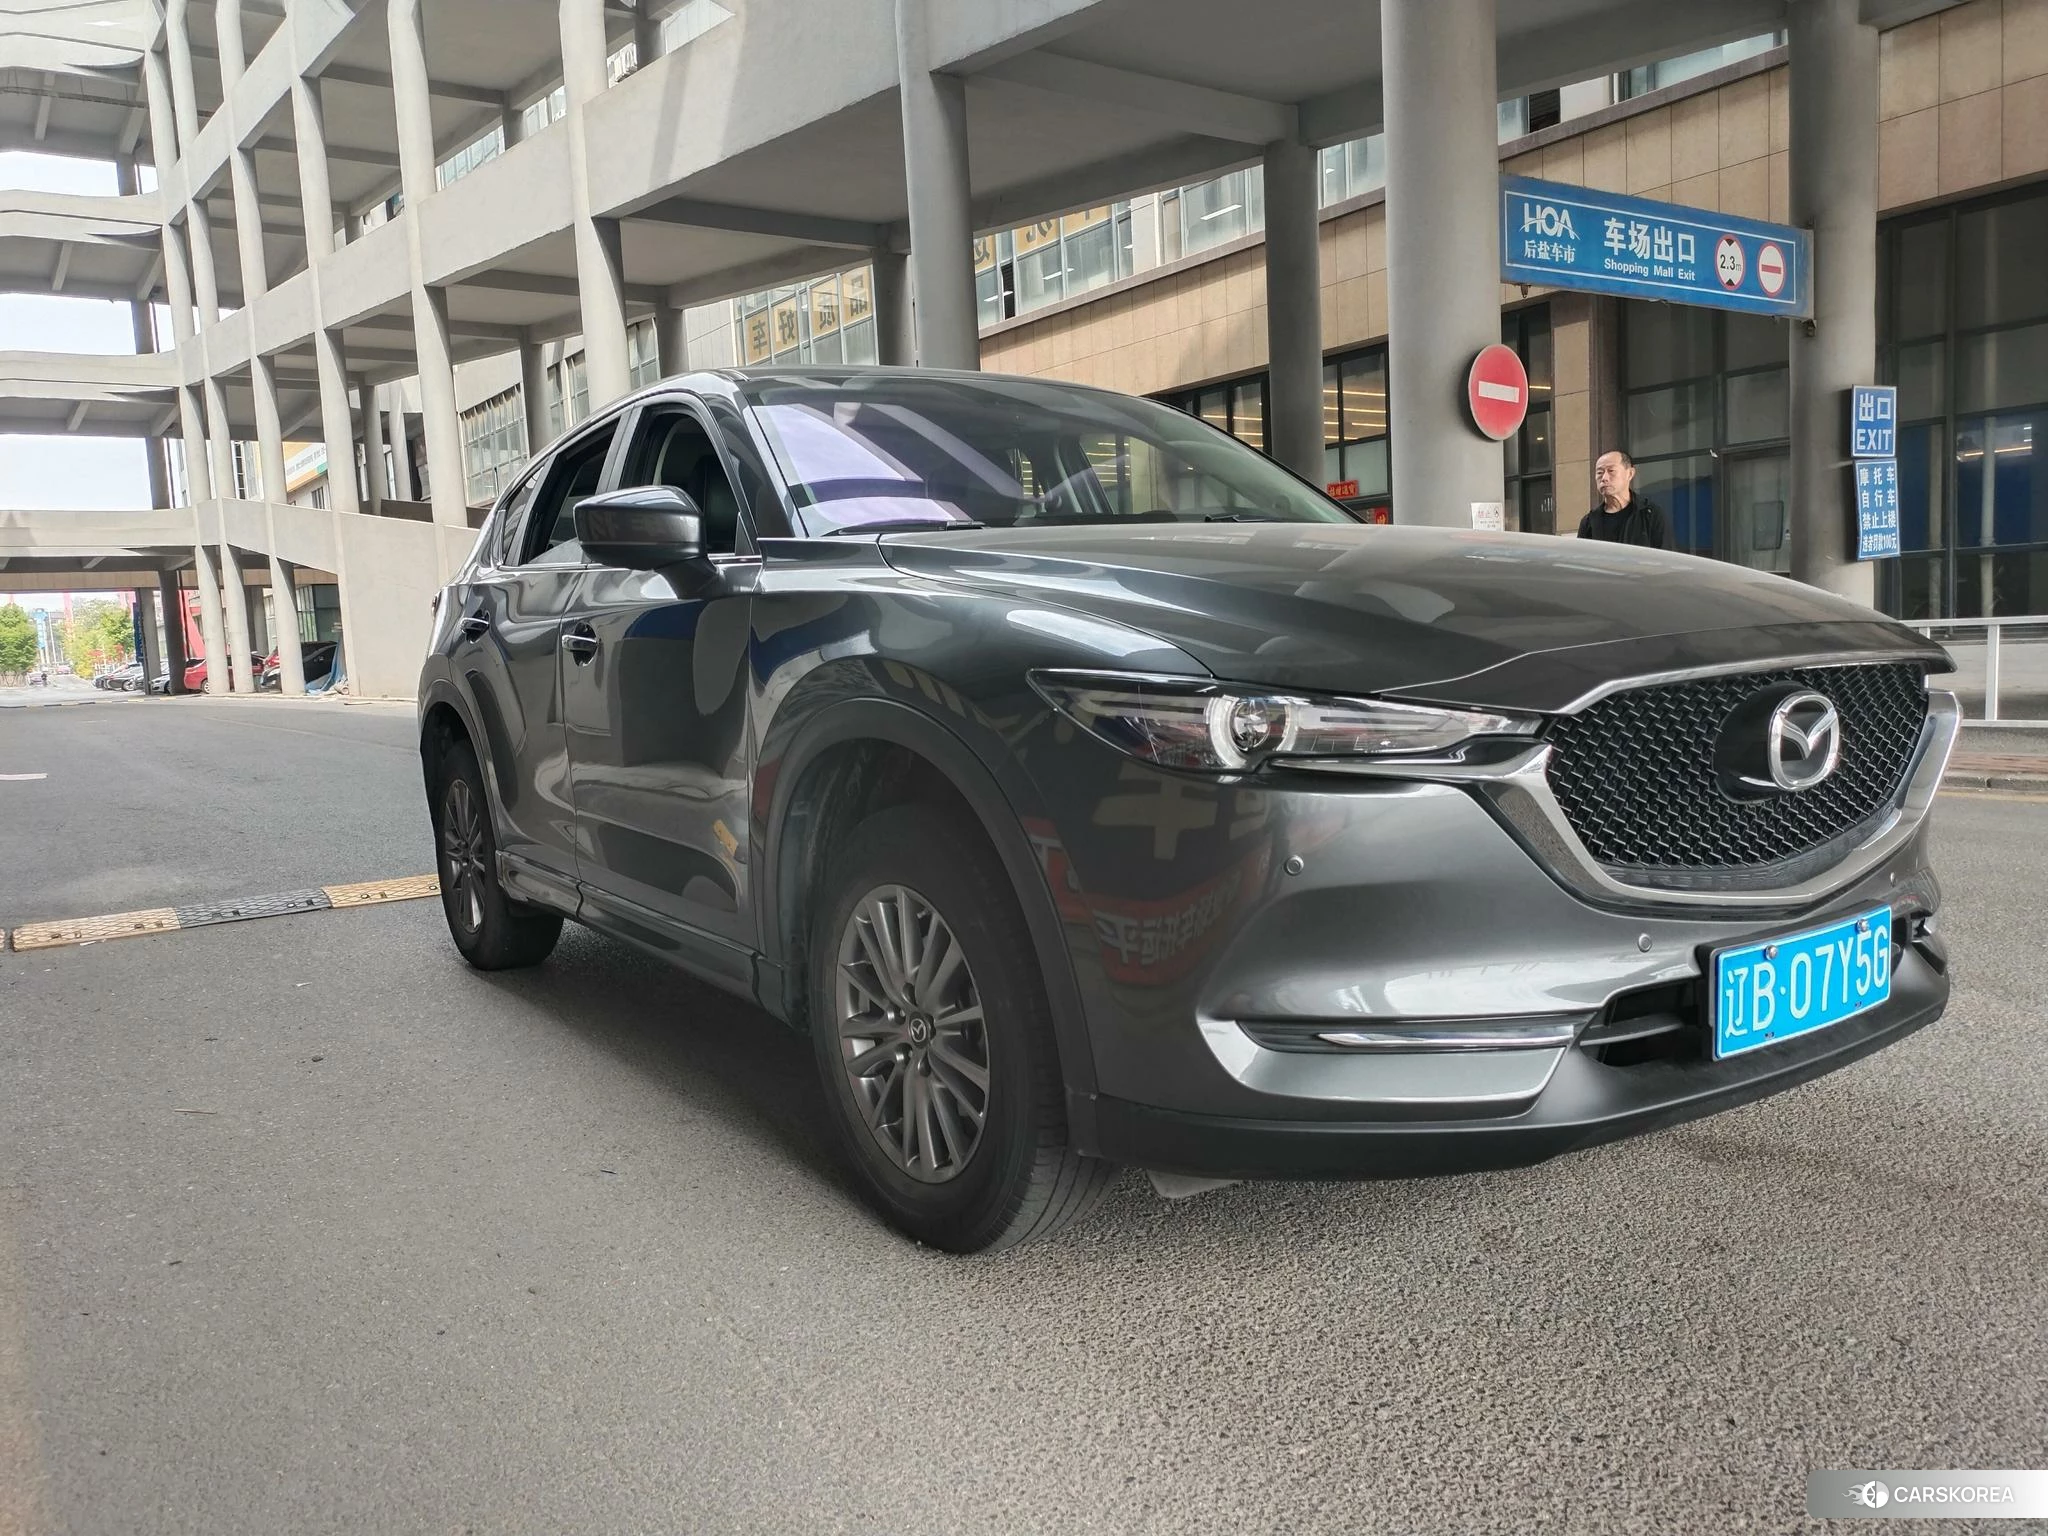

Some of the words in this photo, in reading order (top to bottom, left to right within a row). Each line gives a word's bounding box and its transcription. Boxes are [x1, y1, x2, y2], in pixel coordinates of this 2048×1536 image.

[1523, 202, 1576, 240] HOA
[1523, 239, 1576, 264] 后盐车市
[1603, 216, 1695, 264] 车场出口
[1603, 257, 1649, 277] Shopping
[1653, 265, 1674, 278] Mall
[1678, 268, 1696, 281] Exit
[1858, 392, 1891, 422] 出口
[1856, 428, 1892, 451] EXIT
[1859, 466, 1895, 486] 摩托车
[1861, 488, 1896, 509] 自行车
[1862, 510, 1896, 530] 禁止上楼
